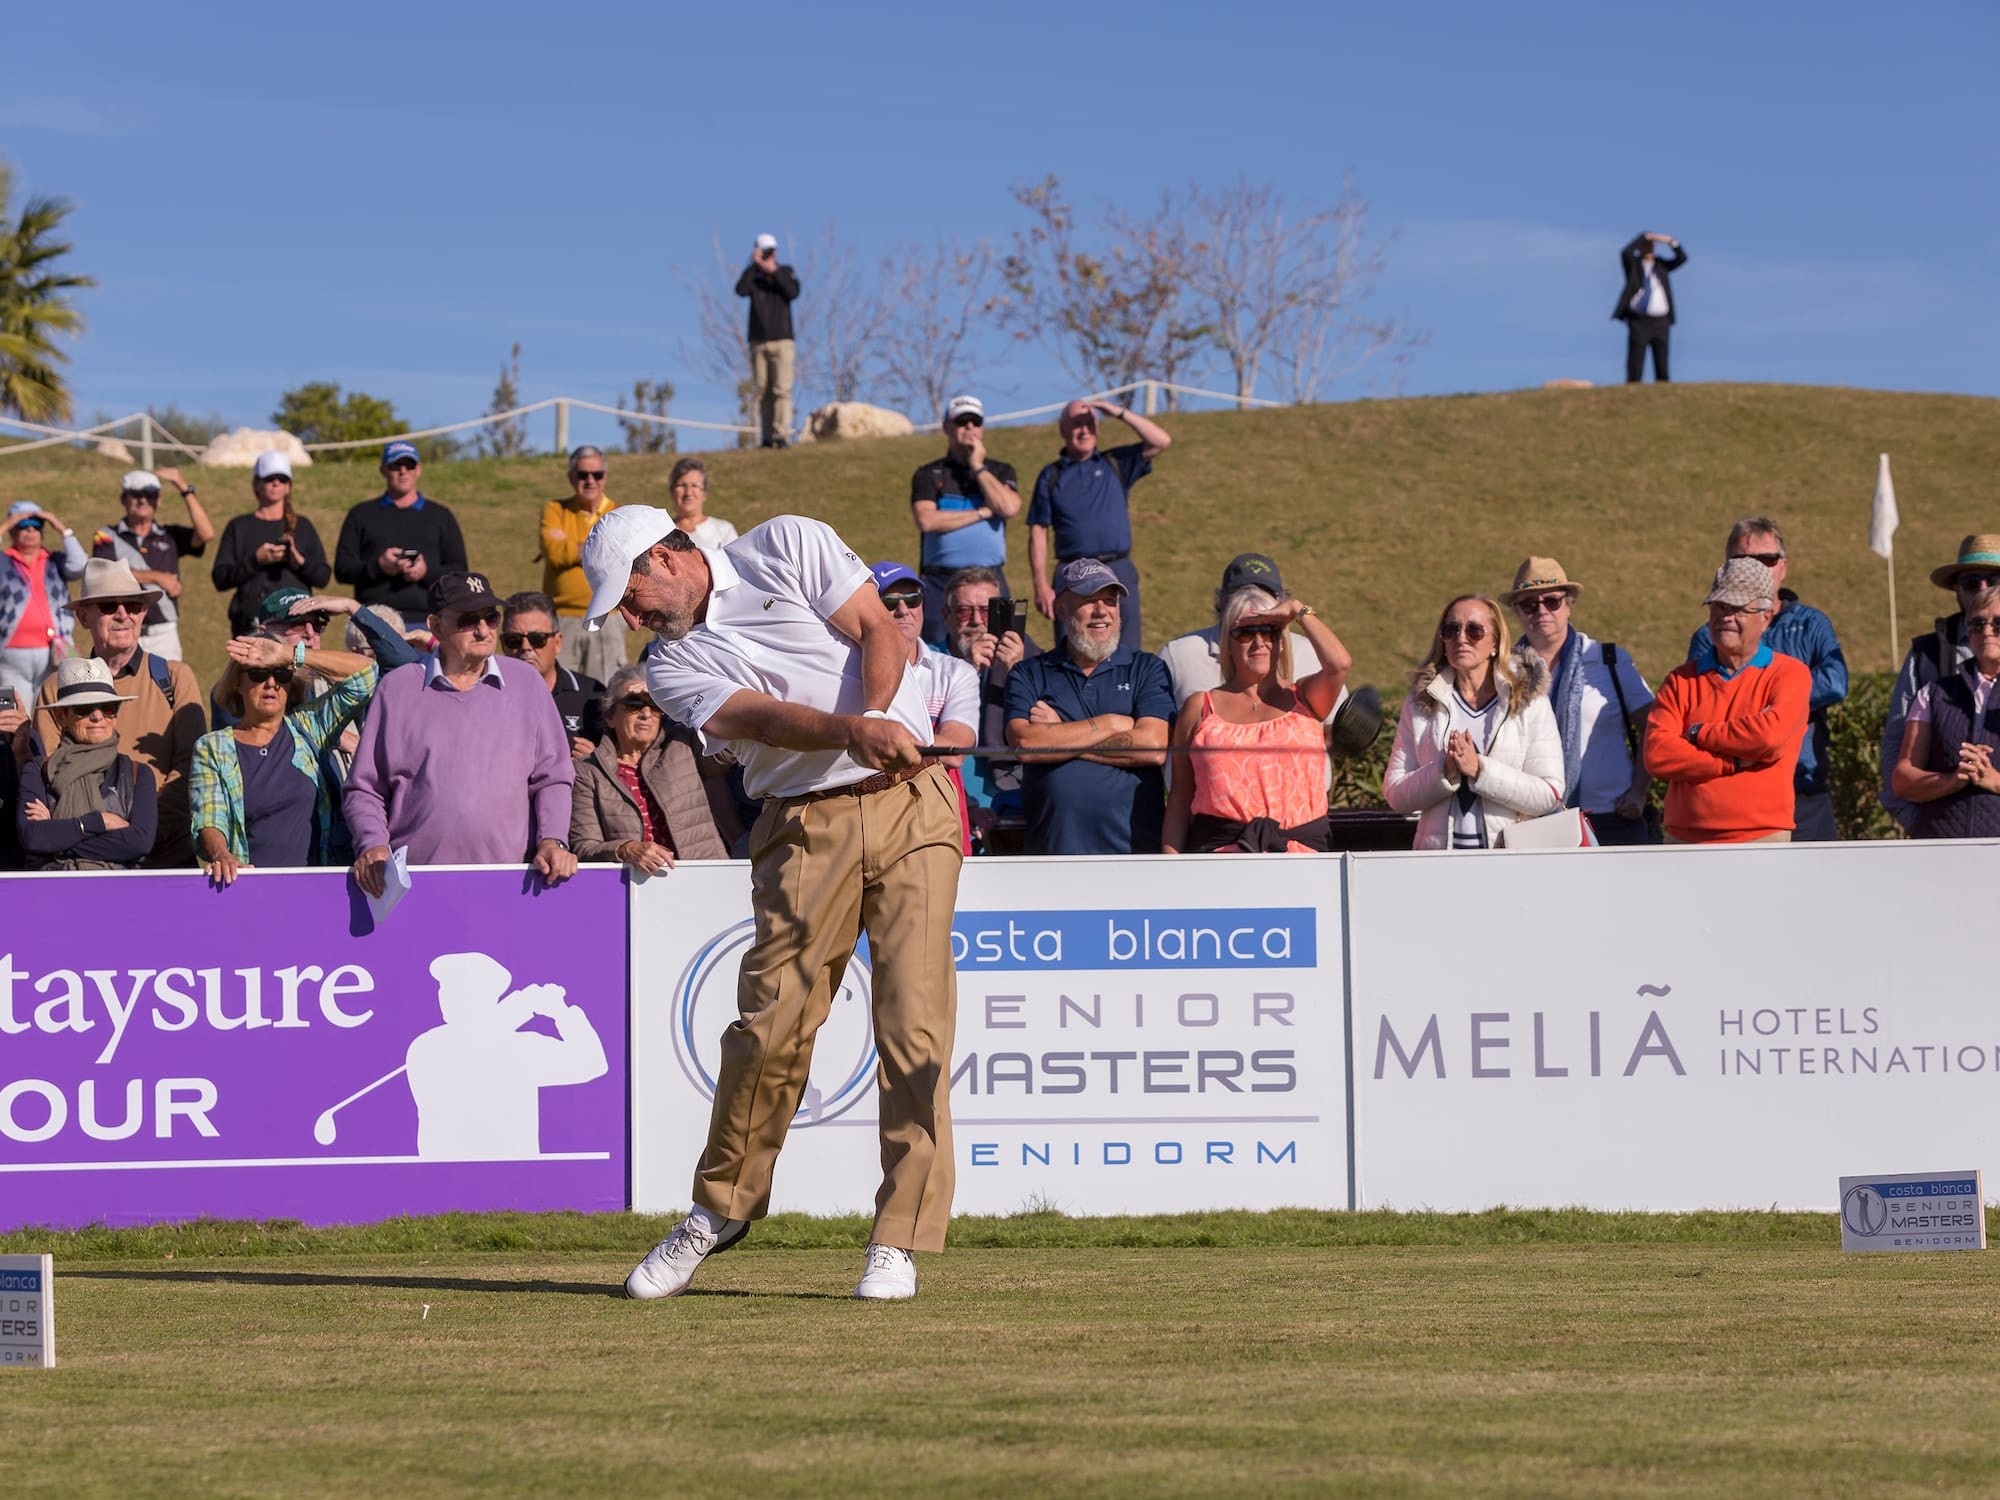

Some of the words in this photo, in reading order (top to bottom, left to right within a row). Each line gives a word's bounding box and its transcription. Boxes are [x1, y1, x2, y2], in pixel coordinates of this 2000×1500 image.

[951, 920, 1062, 962] osta
[1108, 919, 1291, 961] blanca
[0, 953, 375, 1064] taysure
[985, 992, 1295, 1029] ENIOR
[1720, 1006, 1879, 1036] HOTELS
[1720, 1045, 2000, 1075] INTERNATIO
[0, 1078, 220, 1143] OUR
[971, 1141, 1297, 1167] ENIDORM
[1888, 1185, 1923, 1197] costa
[1931, 1183, 1972, 1195] blanca
[1891, 1200, 1974, 1213] SENIOR
[1891, 1214, 1974, 1229] MASTERS
[1894, 1236, 1976, 1246] BENIDORM
[0, 1319, 38, 1337] ERS
